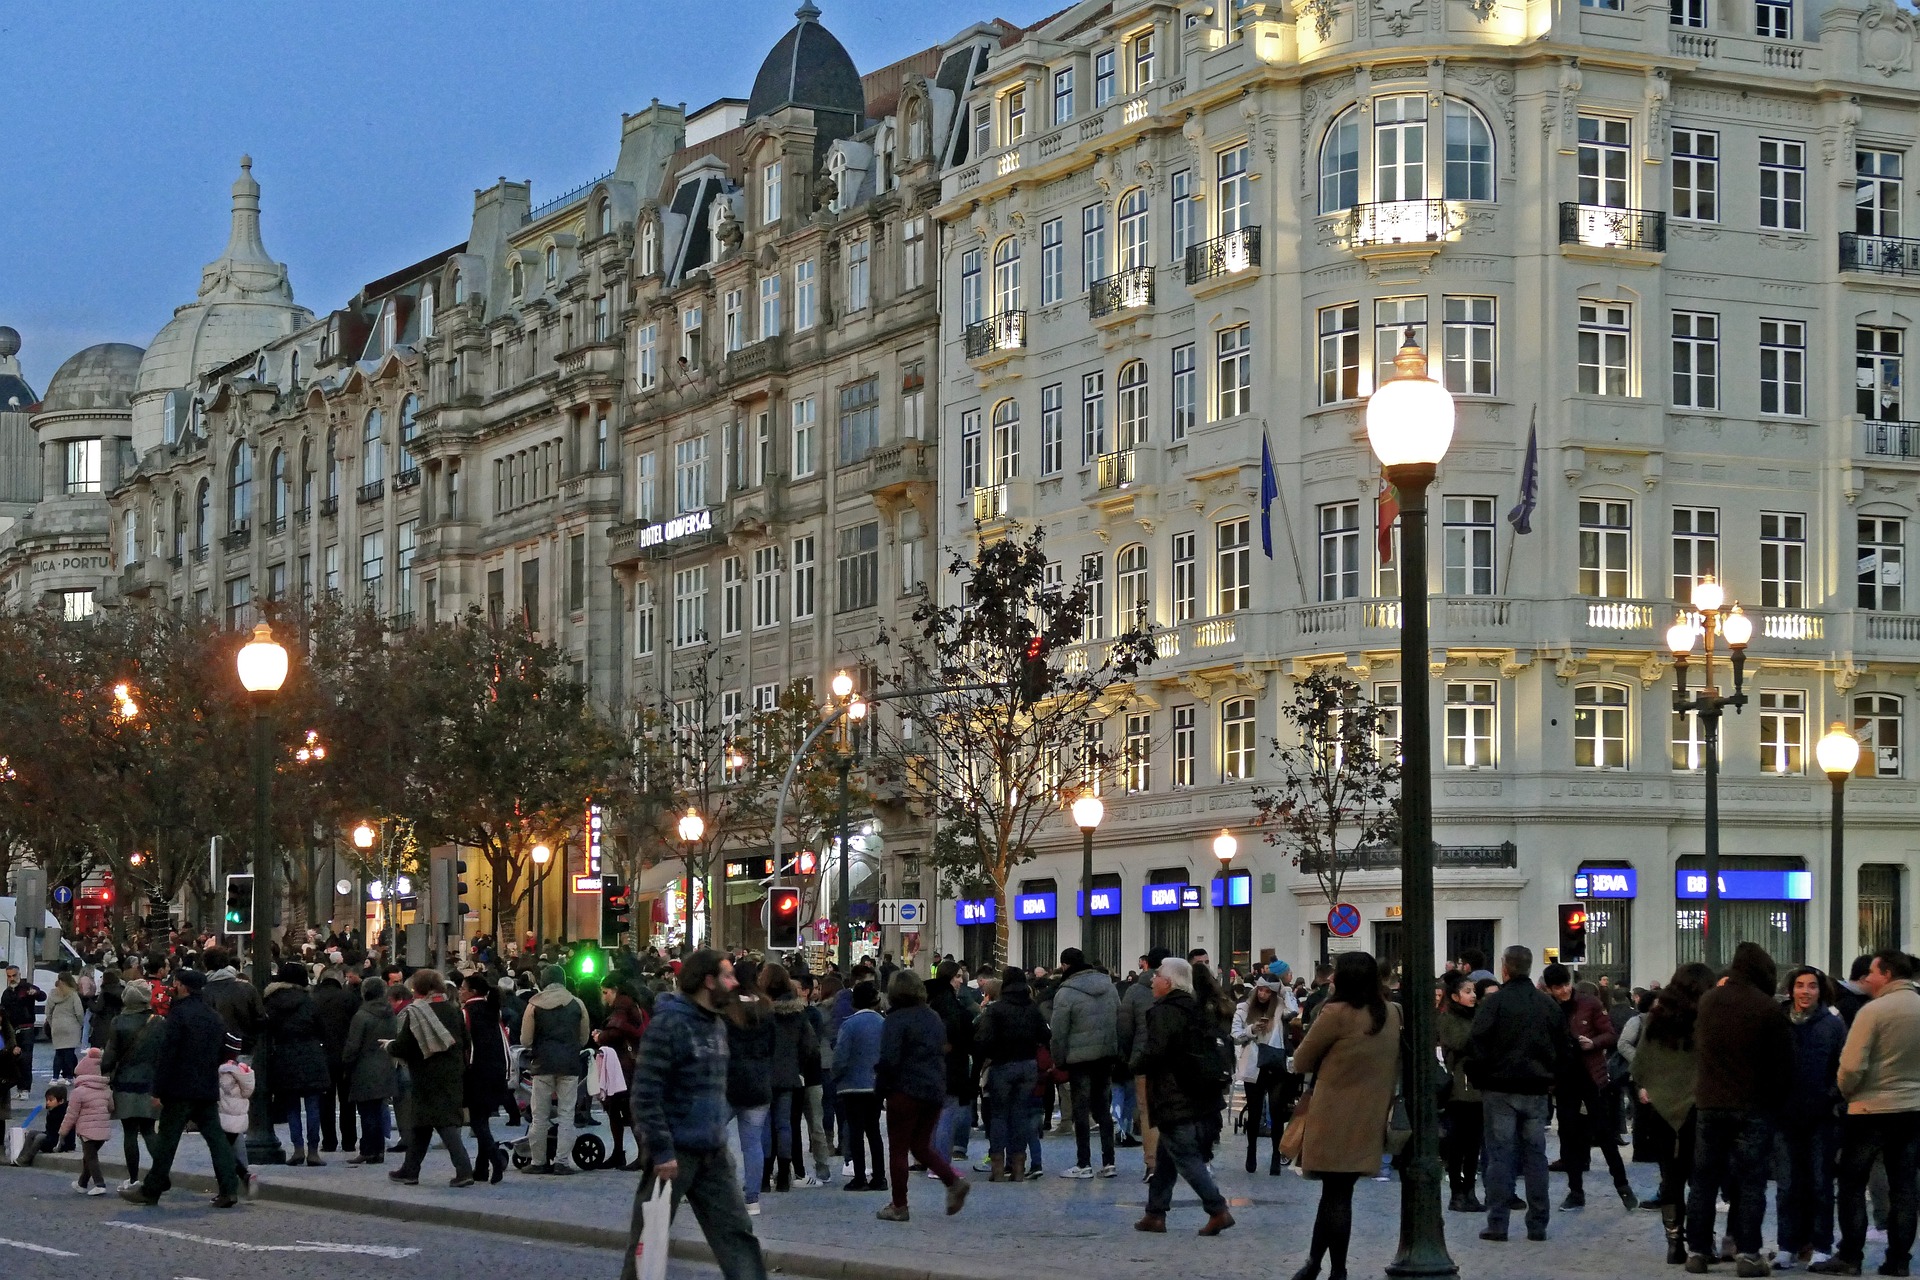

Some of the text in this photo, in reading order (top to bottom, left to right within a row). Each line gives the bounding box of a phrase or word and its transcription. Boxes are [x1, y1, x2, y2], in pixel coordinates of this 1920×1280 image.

[641, 510, 712, 548] HOTEL UNIVERSAL
[62, 556, 110, 570] PORTU
[1687, 876, 1727, 892] BBA
[1091, 894, 1110, 910] BVA
[1151, 889, 1177, 905] BBVA
[1023, 898, 1046, 914] BBVA
